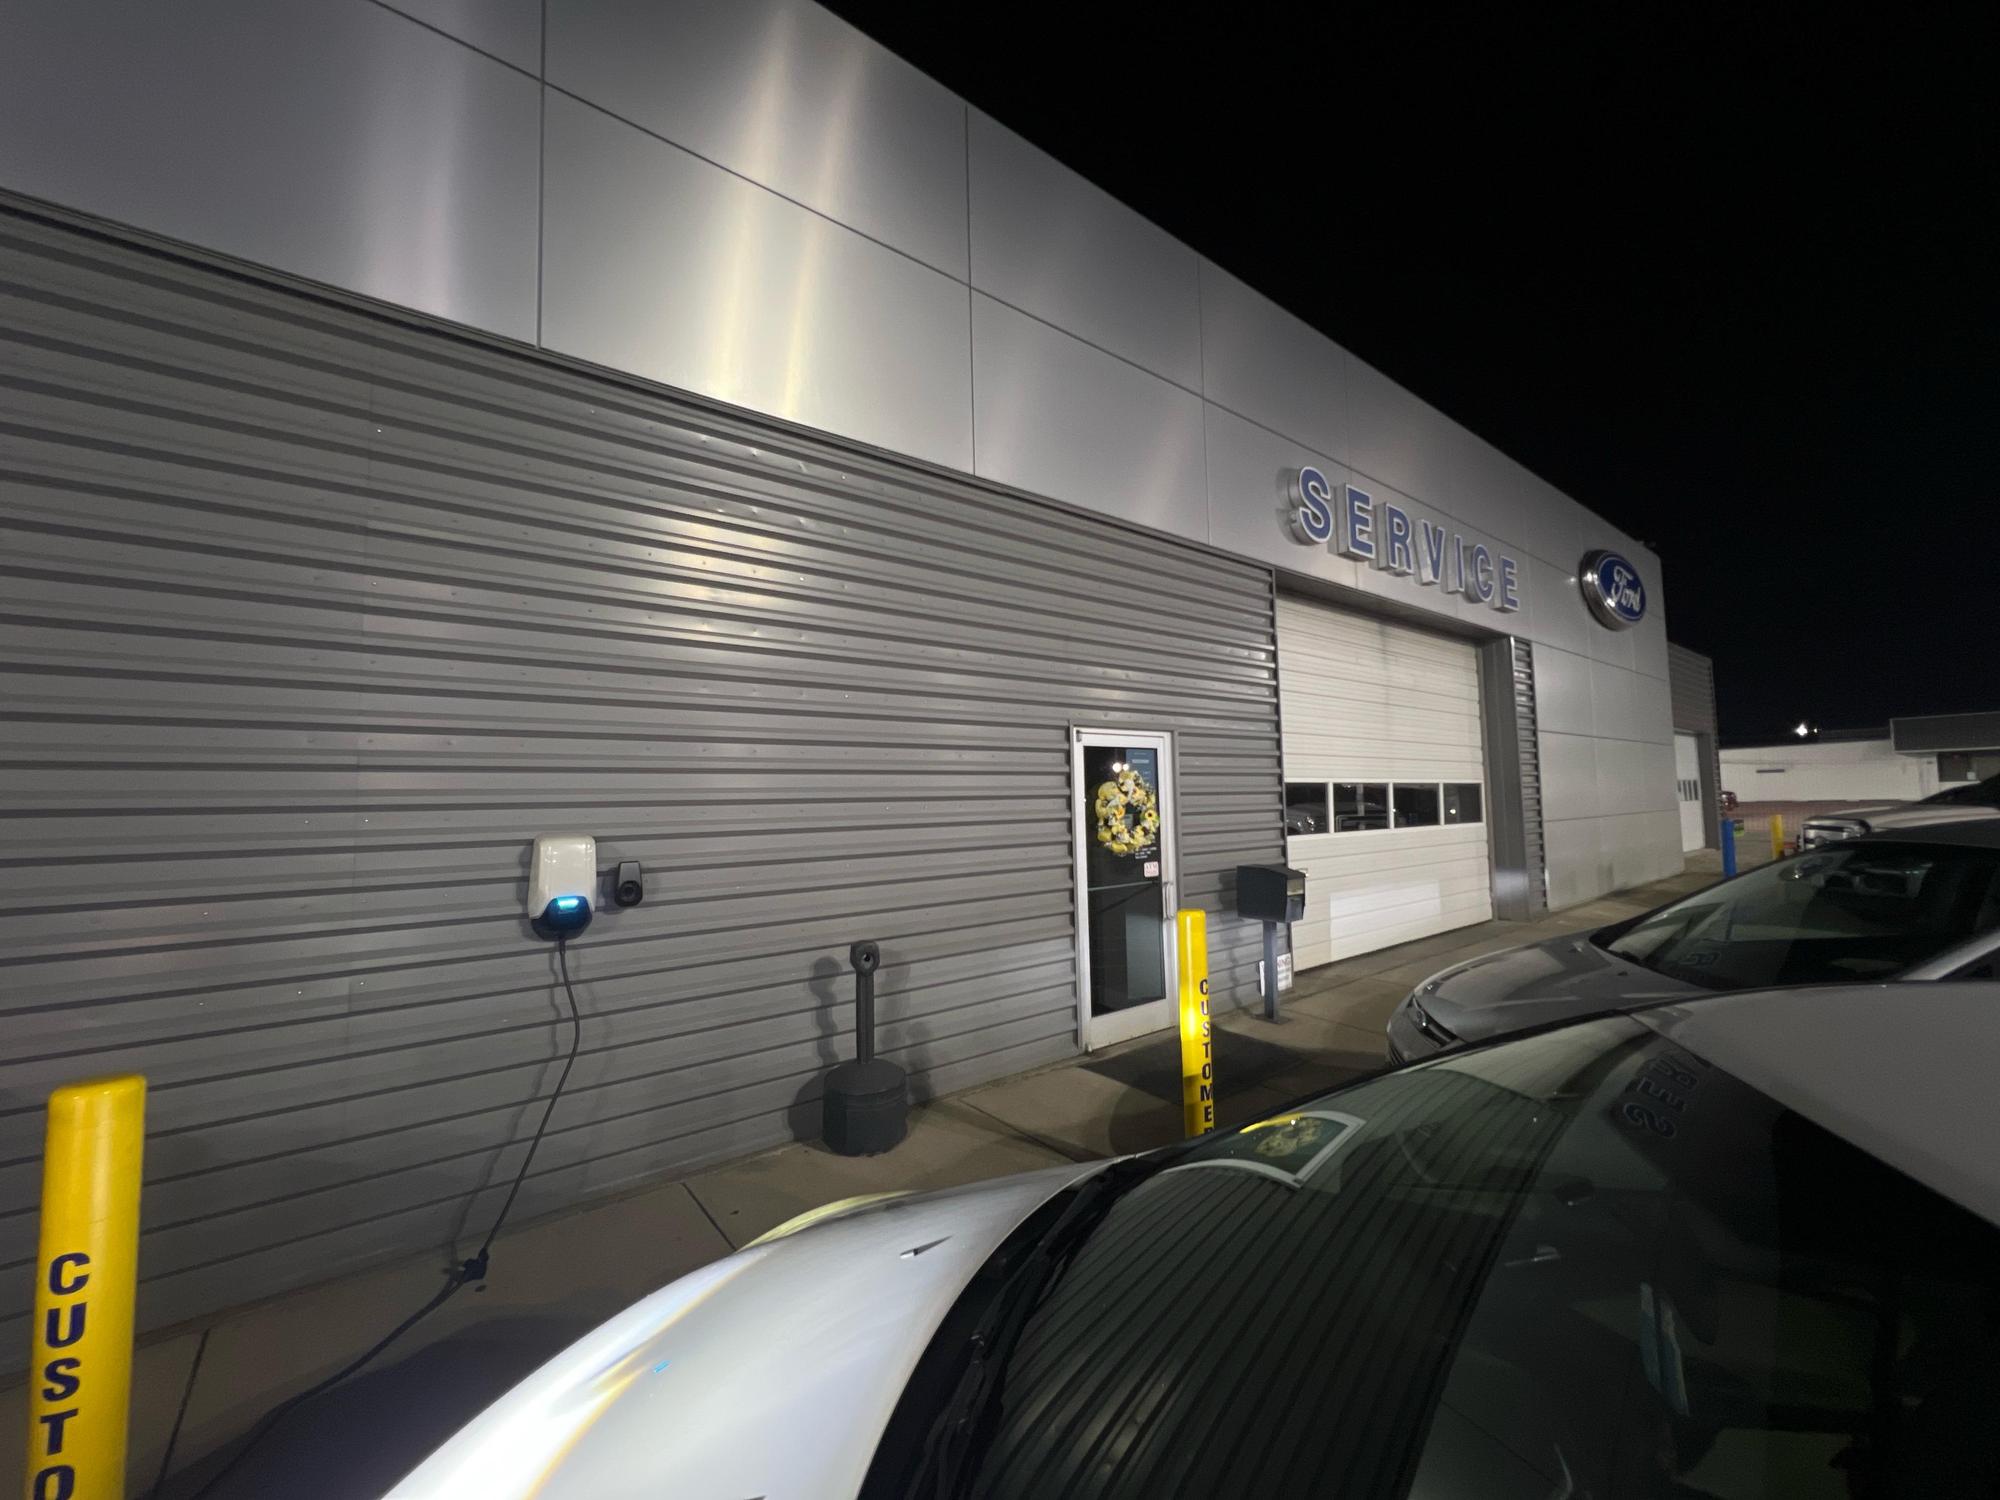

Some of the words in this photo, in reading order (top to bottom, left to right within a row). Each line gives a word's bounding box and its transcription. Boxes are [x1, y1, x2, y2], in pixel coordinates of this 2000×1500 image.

[1298, 466, 1519, 612] SERVICE
[1611, 565, 1641, 612] Ford
[34, 1252, 91, 1500] CUSTO
